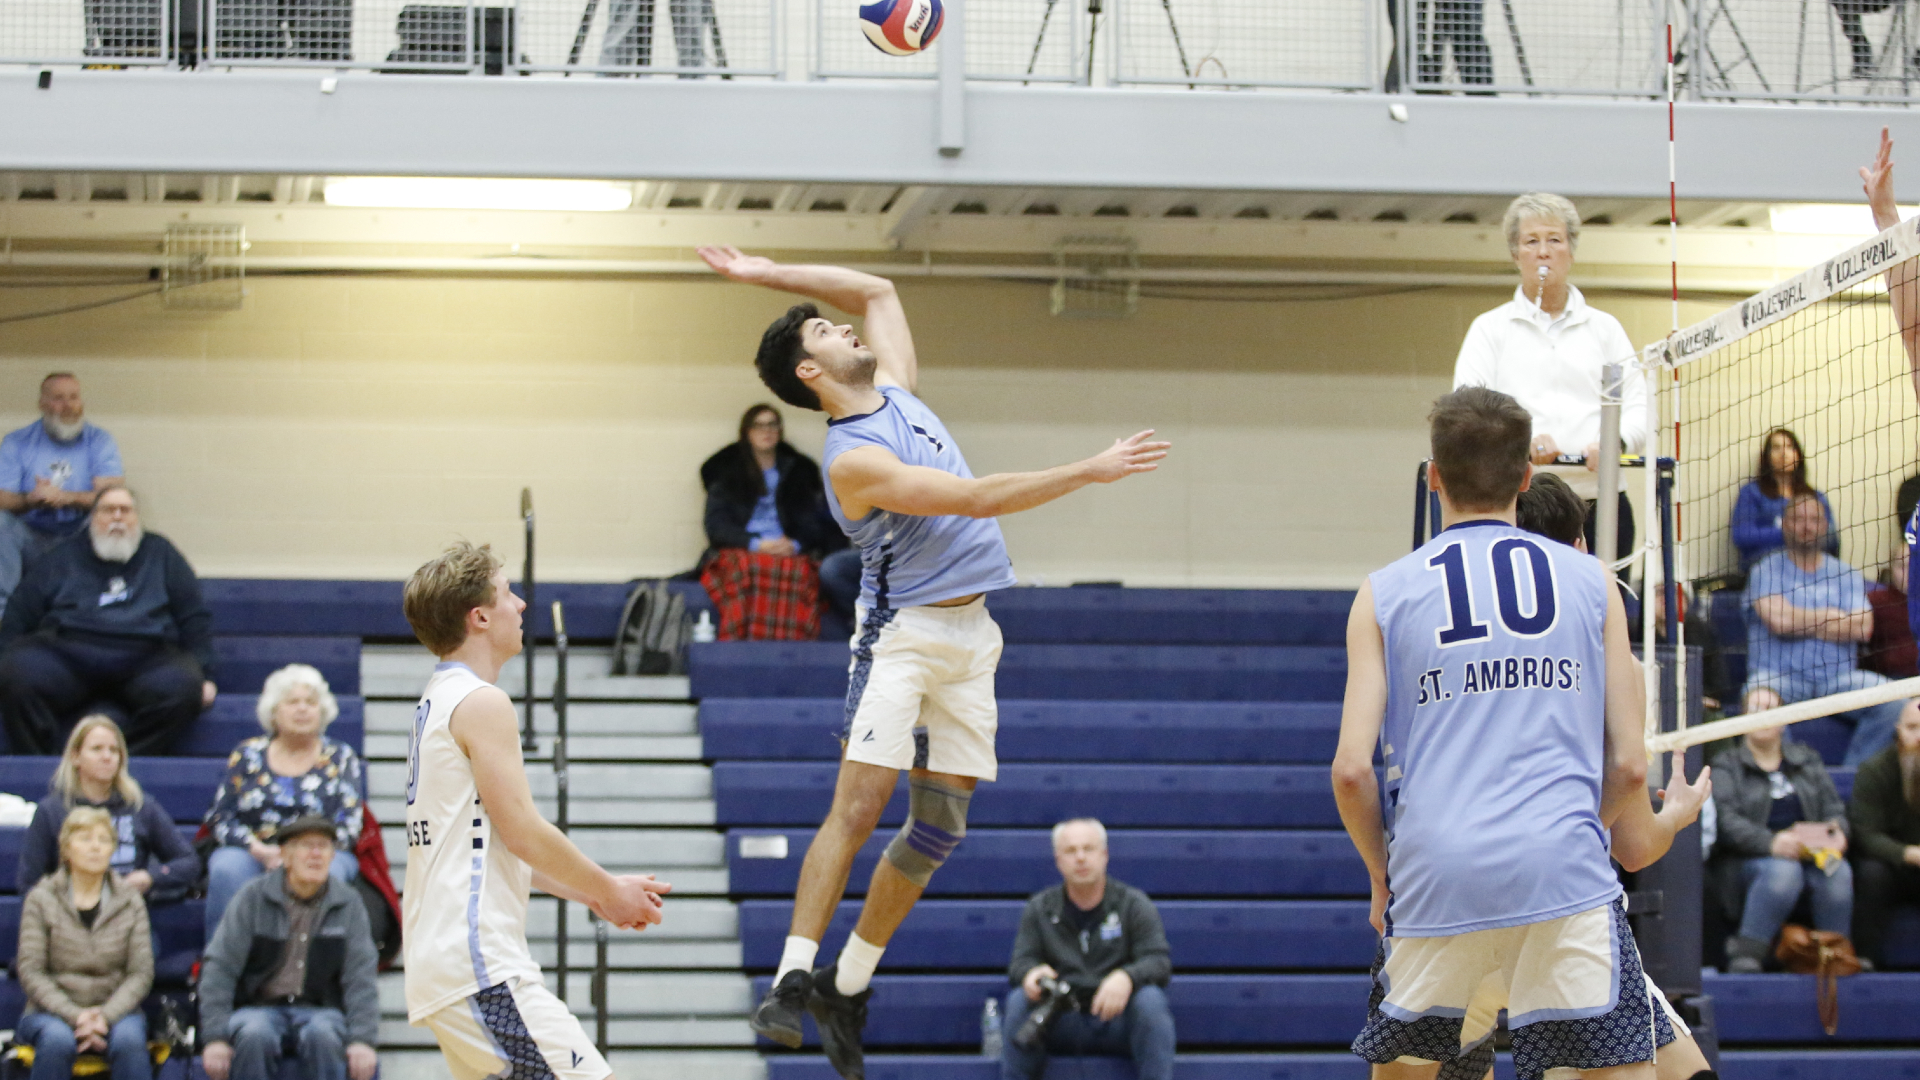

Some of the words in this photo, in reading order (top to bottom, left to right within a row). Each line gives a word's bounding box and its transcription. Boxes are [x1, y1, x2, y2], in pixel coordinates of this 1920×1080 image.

[1751, 282, 1807, 324] VOLEYBAL
[1425, 536, 1560, 649] 10
[1417, 667, 1453, 706] ST.
